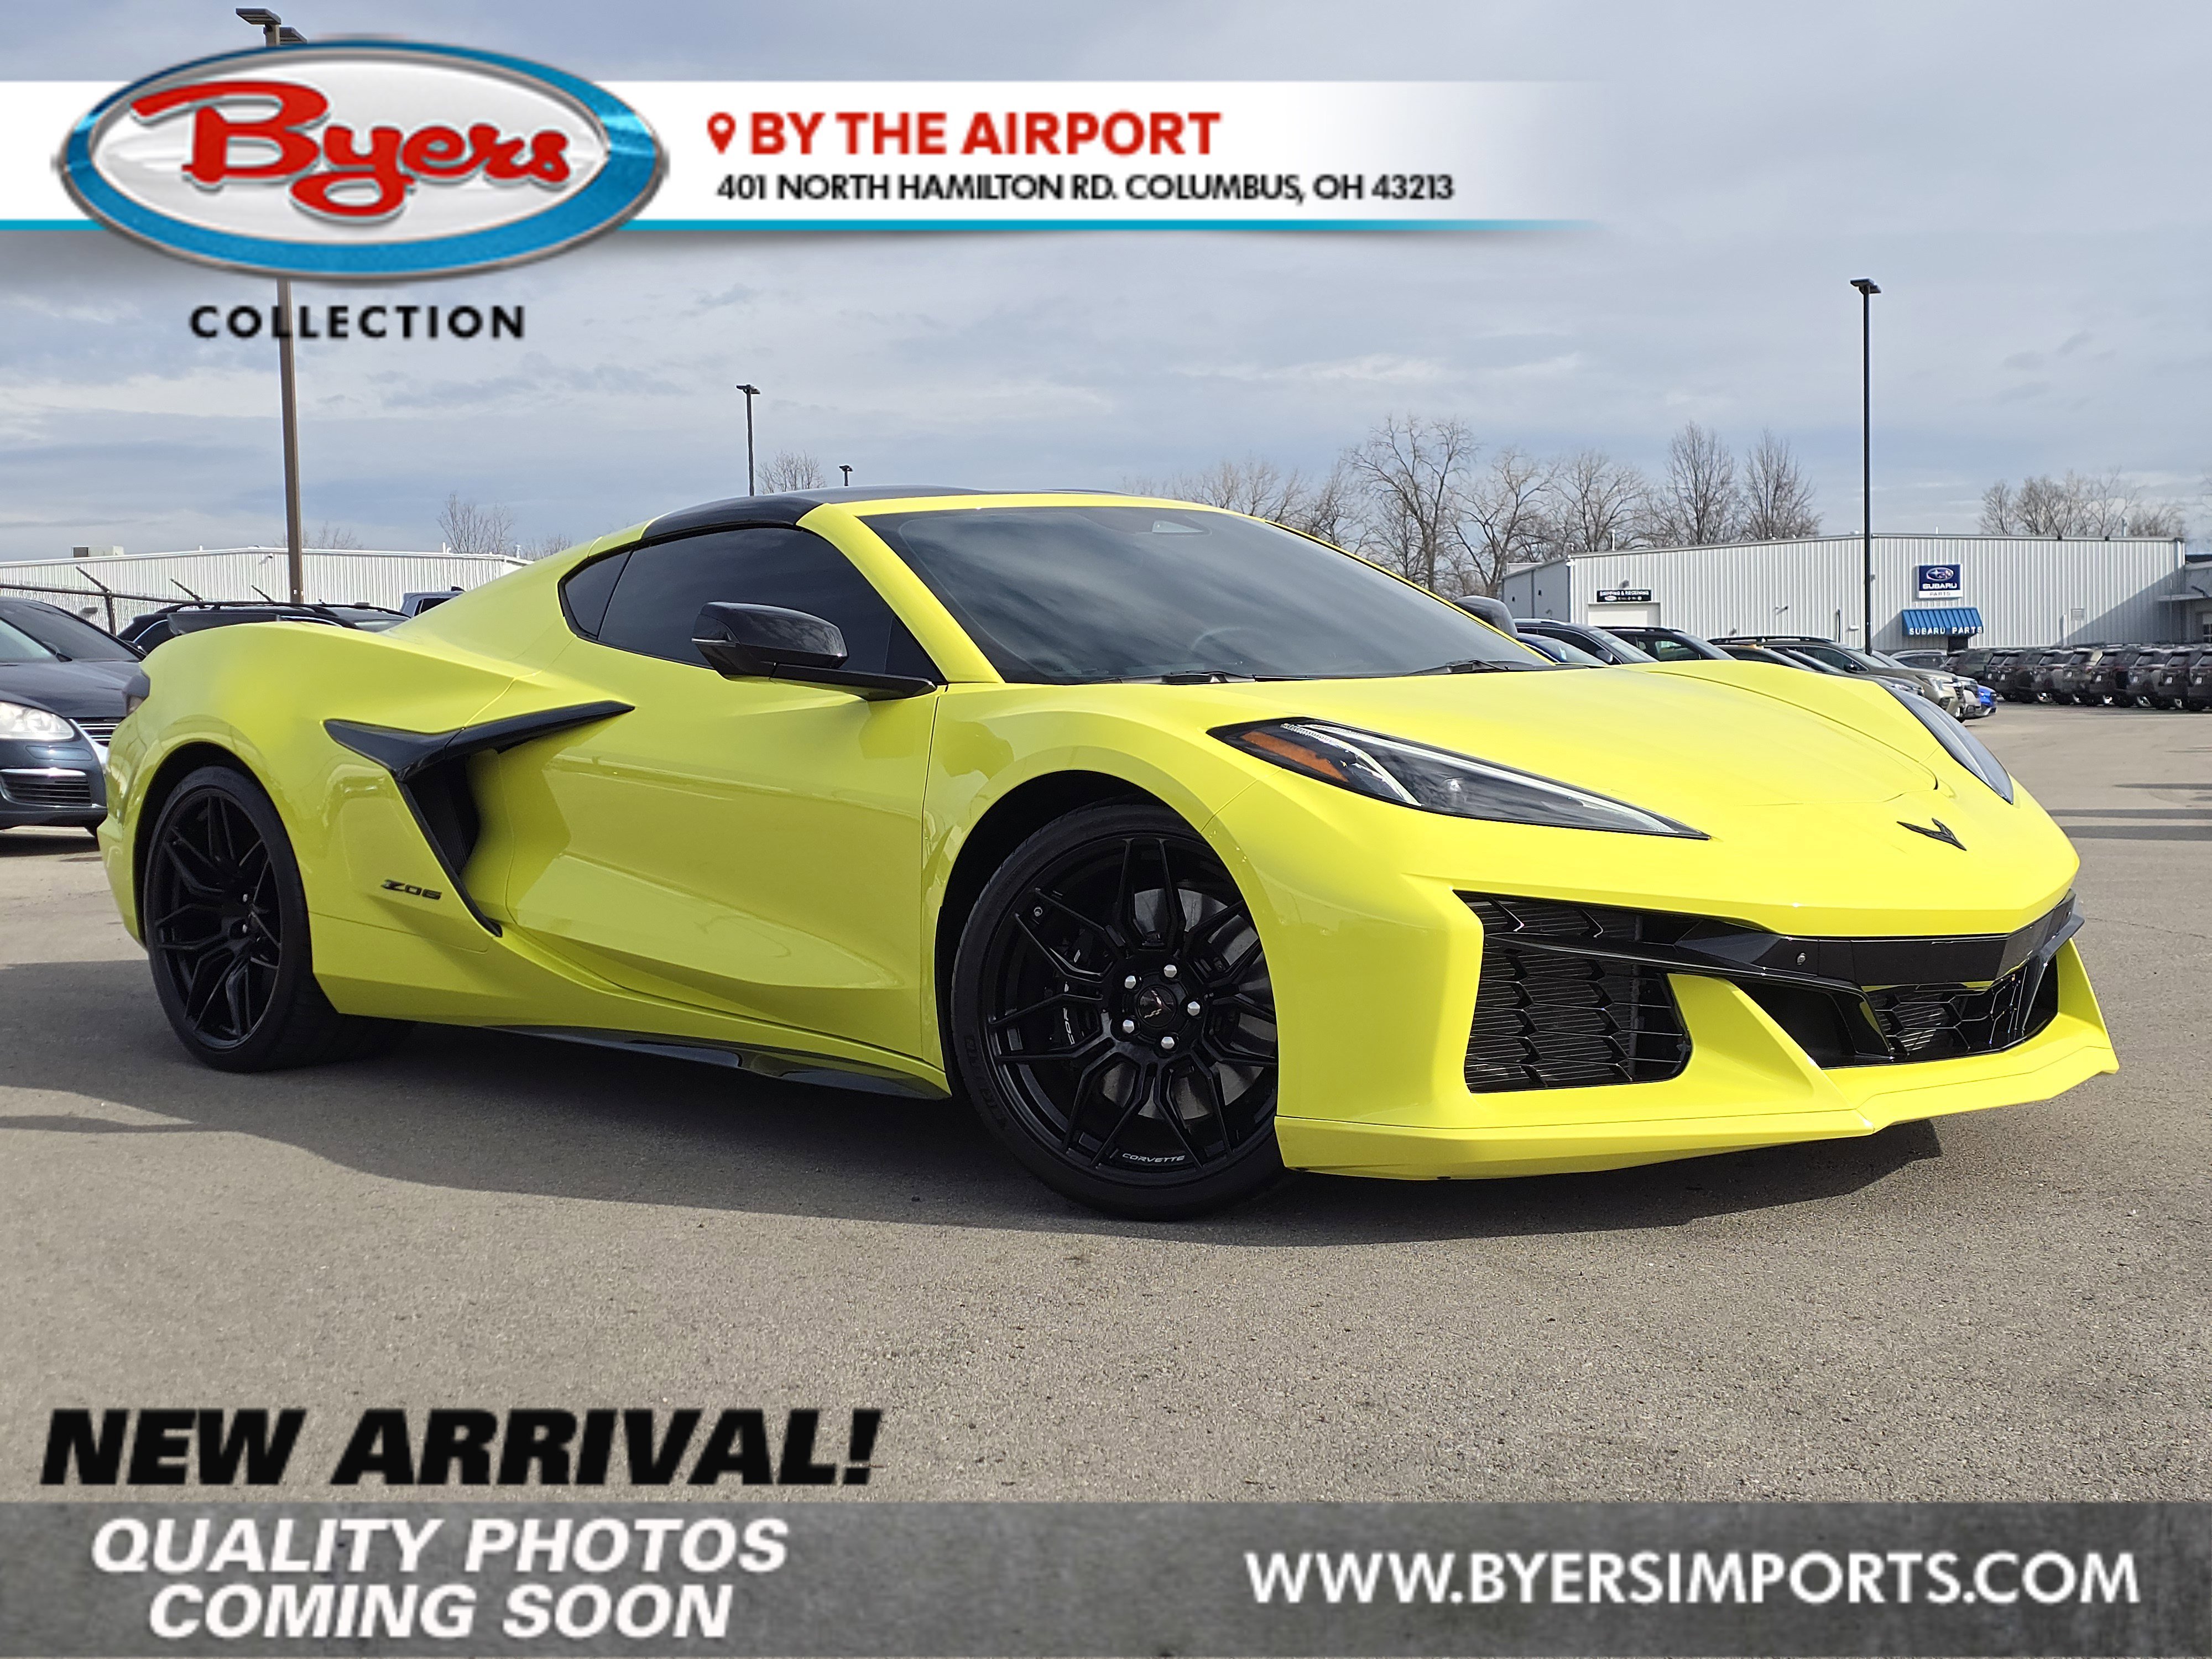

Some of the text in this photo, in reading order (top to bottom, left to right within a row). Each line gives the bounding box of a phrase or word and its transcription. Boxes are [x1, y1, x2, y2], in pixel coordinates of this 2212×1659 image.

[1909, 626, 1983, 635] SUBARU PARTS
[1122, 1153, 1186, 1163] CORVETTE
